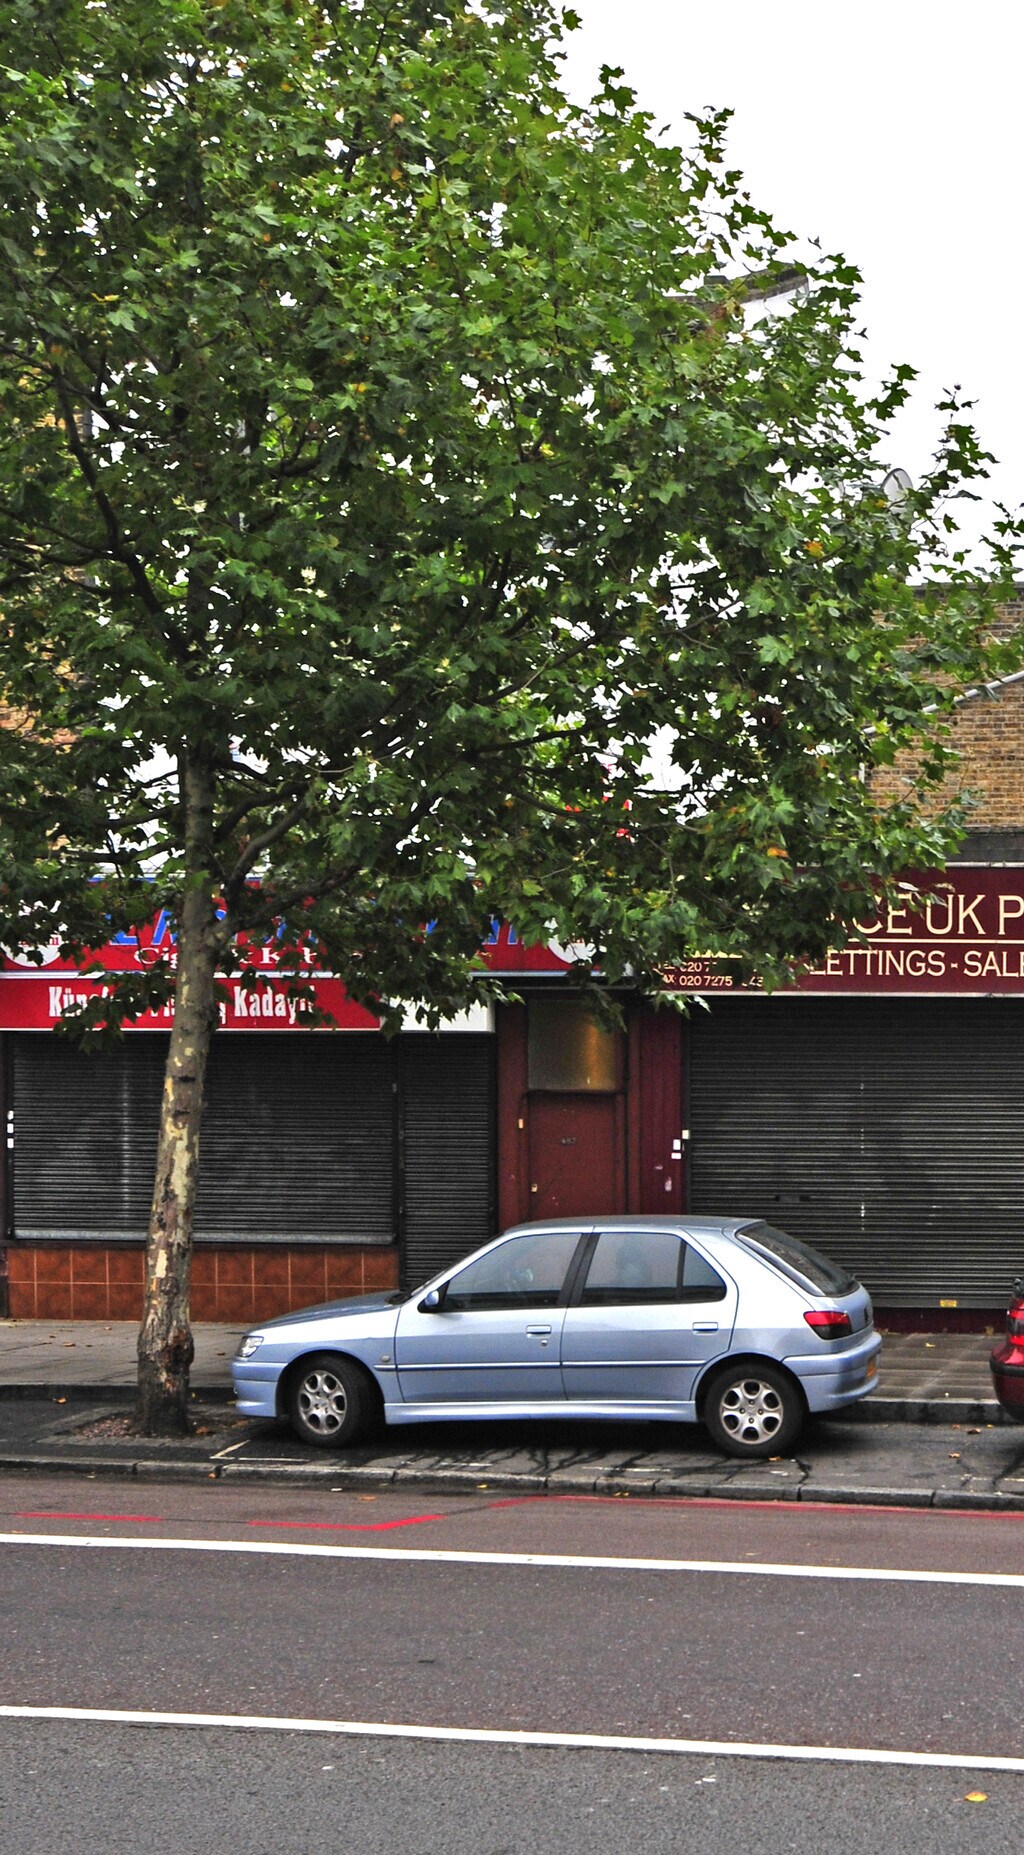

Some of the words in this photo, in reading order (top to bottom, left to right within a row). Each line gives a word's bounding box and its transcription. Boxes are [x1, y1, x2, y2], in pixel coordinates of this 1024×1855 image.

[926, 894, 986, 935] UK
[679, 975, 702, 986] 020
[704, 975, 733, 987] 7275
